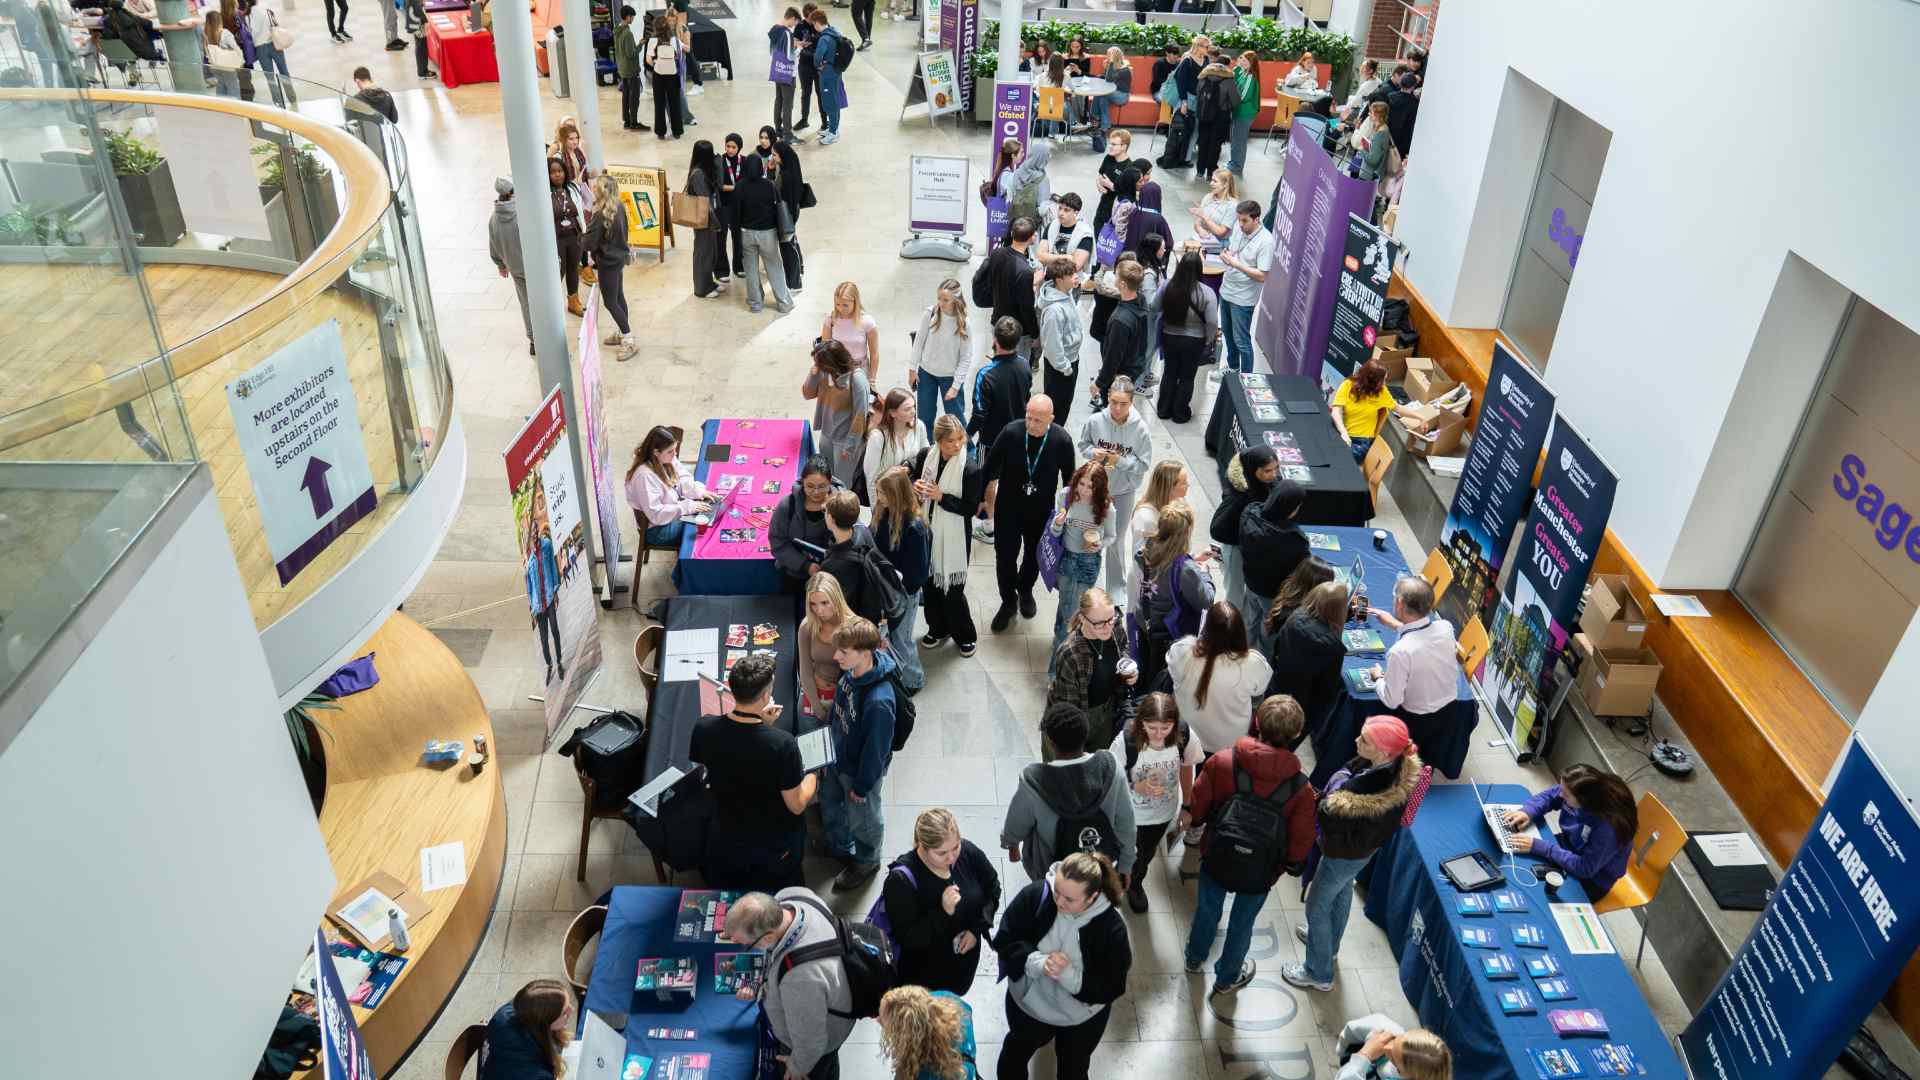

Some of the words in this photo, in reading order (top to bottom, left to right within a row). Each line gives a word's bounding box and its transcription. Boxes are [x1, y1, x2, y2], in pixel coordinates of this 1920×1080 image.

[998, 111, 1025, 120] Ofsted
[999, 103, 1012, 112] We
[1279, 178, 1296, 214] FIND
[252, 401, 283, 427] More
[284, 365, 334, 407] exhibitors
[271, 416, 290, 434] are
[291, 387, 327, 421] located
[263, 421, 309, 457] upstairs
[309, 411, 323, 426] on
[323, 398, 339, 416] the
[274, 436, 313, 469] Second
[313, 416, 339, 441] Floor
[1097, 439, 1112, 449] New
[552, 489, 568, 514] with
[1535, 490, 1588, 562] Manchester
[1547, 486, 1583, 535] Greater
[1533, 541, 1563, 590] YOU
[1536, 523, 1569, 572] Greater
[1874, 825, 1896, 857] University
[1877, 819, 1893, 841] Harper
[1891, 841, 1906, 863] Adams
[1791, 874, 1815, 913] Agriculture
[1820, 812, 1846, 852] WE
[1837, 842, 1869, 888] ARE
[1860, 876, 1897, 941] HERE.
[1760, 924, 1785, 972] Technologies
[1764, 917, 1775, 937] Data
[1773, 935, 1789, 964] Science
[1790, 968, 1805, 994] Future
[1772, 902, 1792, 935] Business
[1790, 933, 1816, 982] Management
[1782, 889, 1798, 914] Animal
[1796, 912, 1815, 945] Sciences
[1816, 949, 1833, 982] Zoology
[1751, 939, 1774, 983] Engineering
[1718, 994, 1738, 1036] Professions
[1730, 974, 1741, 993] Food
[1739, 992, 1753, 1020] Science
[1754, 1025, 1772, 1066] Innovation
[1738, 960, 1756, 994] Property
[1754, 991, 1777, 1040] Management
[1739, 1024, 1754, 1057] Sciences
[1766, 1001, 1789, 1053] Conservation
